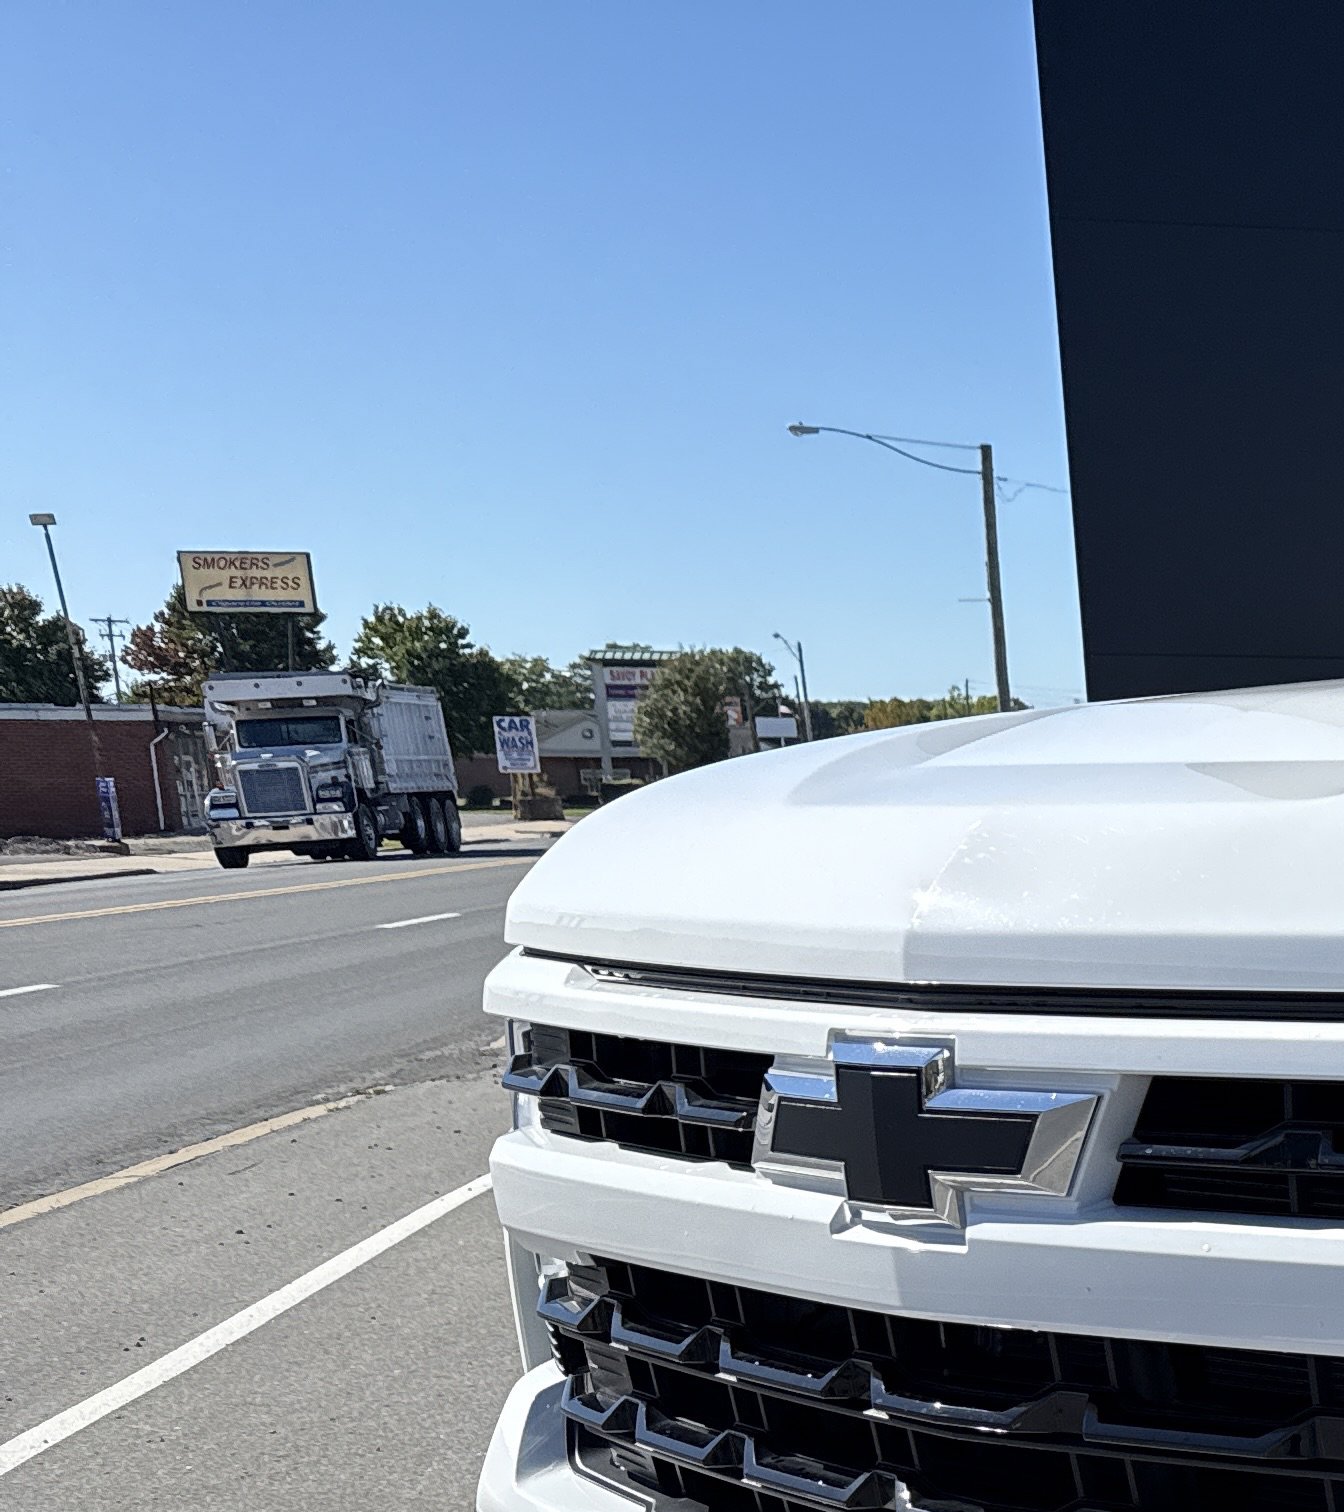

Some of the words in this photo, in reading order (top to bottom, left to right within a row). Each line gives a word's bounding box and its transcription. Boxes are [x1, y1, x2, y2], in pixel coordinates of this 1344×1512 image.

[191, 556, 270, 571] SMOKERS
[228, 575, 301, 591] EXPRESS
[496, 718, 532, 732] CAR
[498, 736, 534, 750] WASH
